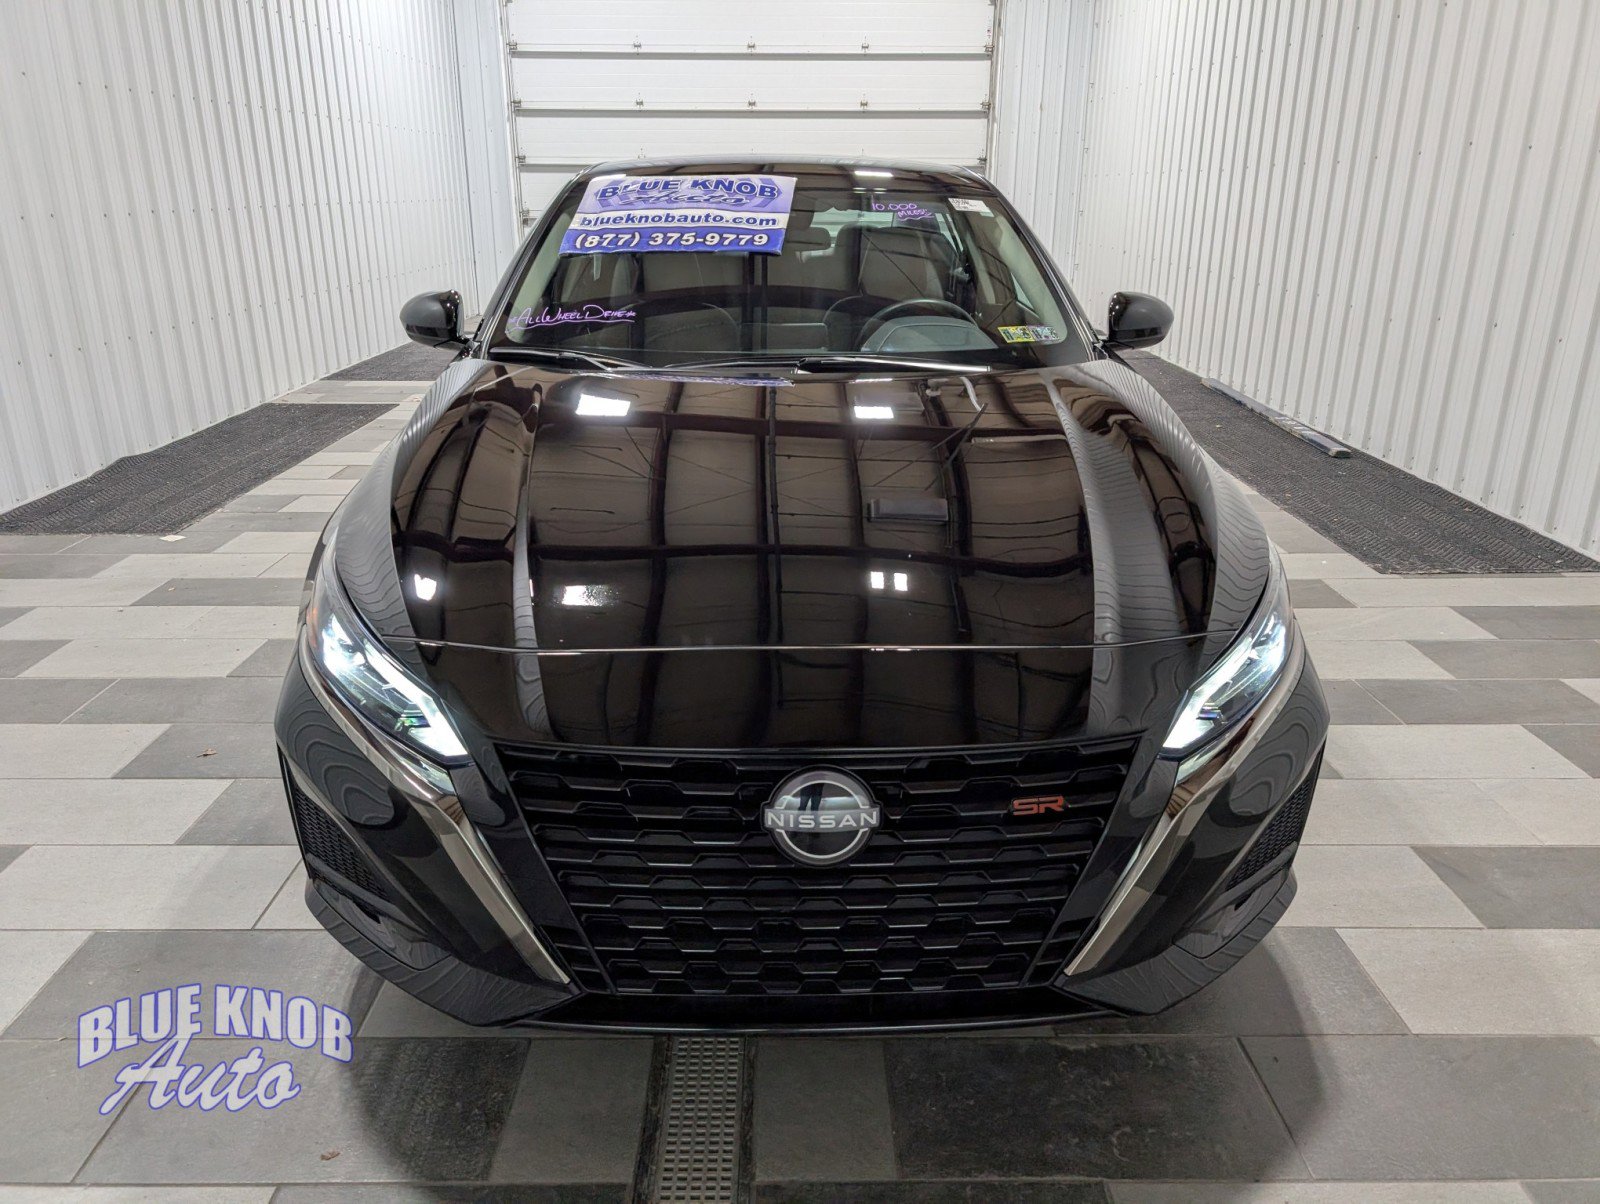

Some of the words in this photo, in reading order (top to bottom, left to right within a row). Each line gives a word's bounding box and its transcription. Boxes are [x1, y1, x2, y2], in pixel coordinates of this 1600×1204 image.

[597, 179, 680, 199] BLUE
[691, 179, 778, 198] KNOB
[580, 213, 777, 227] blueknobauto.com
[575, 231, 640, 249] (877)
[648, 232, 769, 247] 375-9779
[1013, 795, 1065, 816] SR
[767, 811, 877, 828] NISSAN
